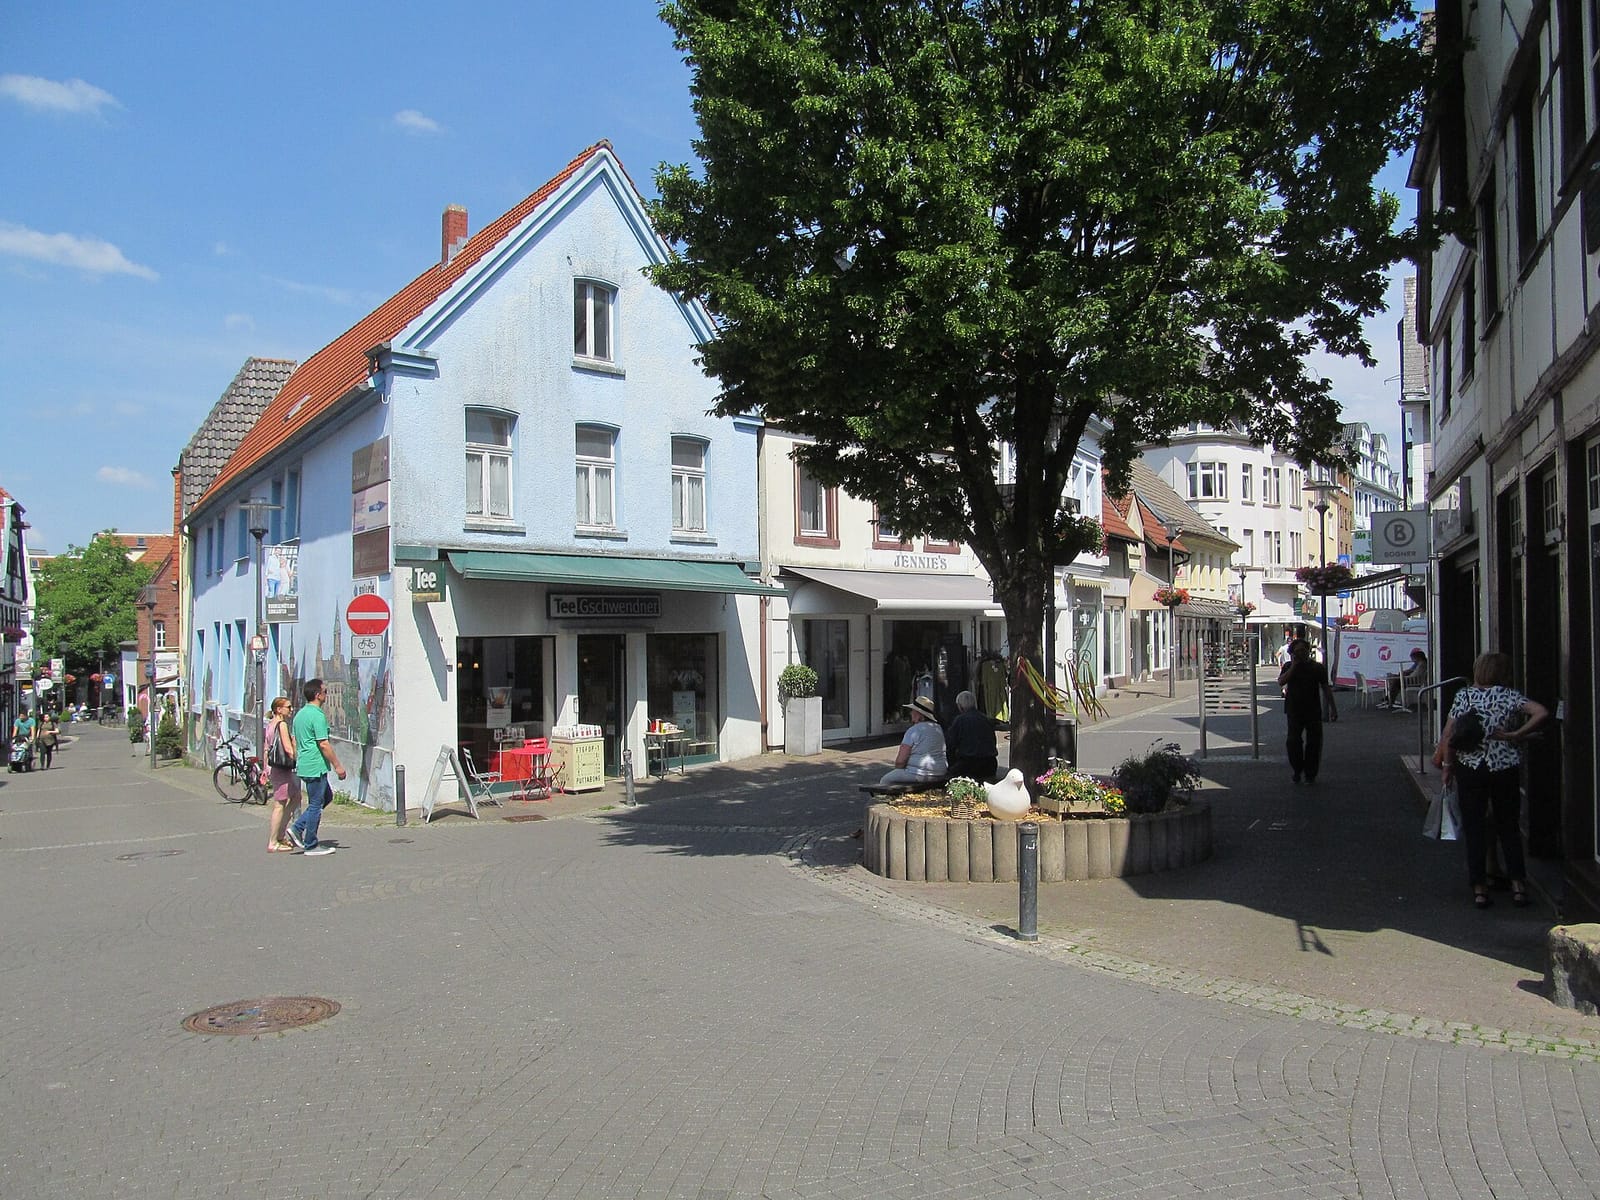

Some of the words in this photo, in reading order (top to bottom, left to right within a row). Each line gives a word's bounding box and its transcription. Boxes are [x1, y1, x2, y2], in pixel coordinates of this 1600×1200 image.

[1393, 524, 1407, 541] B
[894, 554, 947, 570] JENNIE'S
[1384, 550, 1416, 558] BOGNER
[415, 567, 437, 589] Tee
